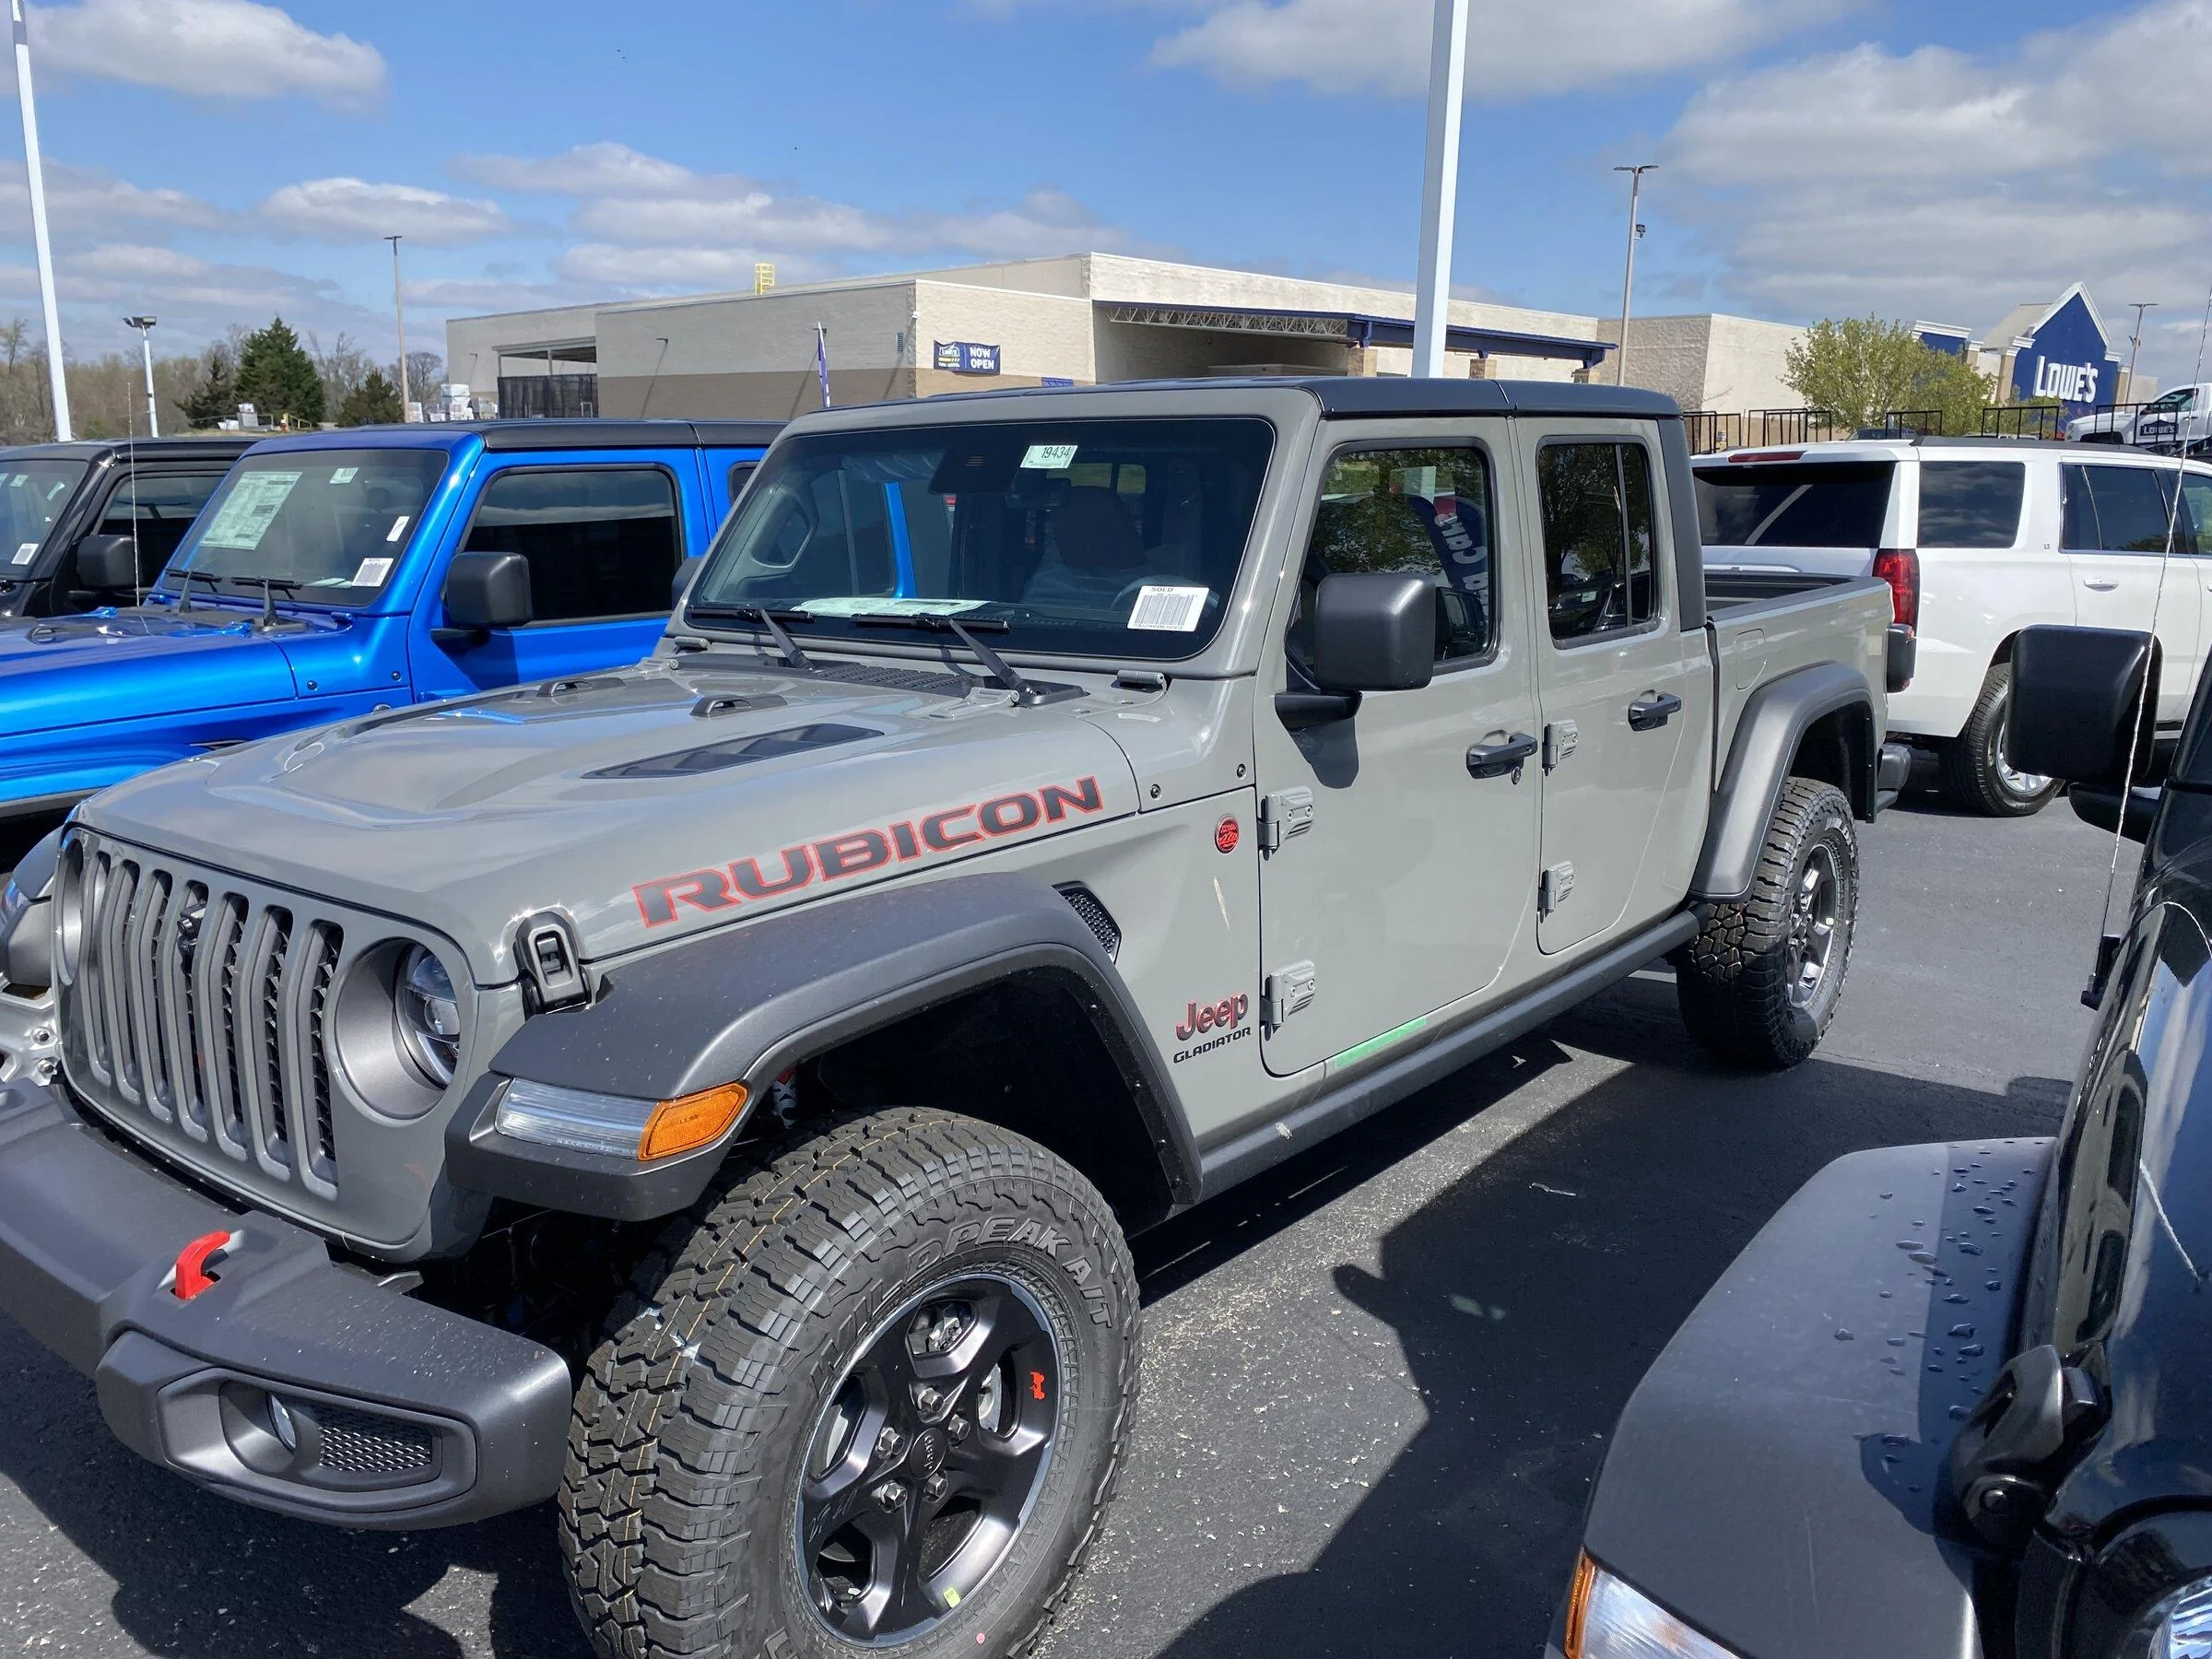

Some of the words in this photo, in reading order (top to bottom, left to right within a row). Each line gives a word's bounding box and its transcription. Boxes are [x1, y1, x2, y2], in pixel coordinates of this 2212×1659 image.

[970, 347, 991, 359] NOW
[971, 358, 994, 370] OPEN
[2033, 355, 2099, 404] LOWE'S
[1041, 446, 1072, 459] 19434
[631, 775, 1104, 928] RUBICON
[1175, 993, 1249, 1041] Jeep
[1172, 1026, 1252, 1065] GLADIATOR
